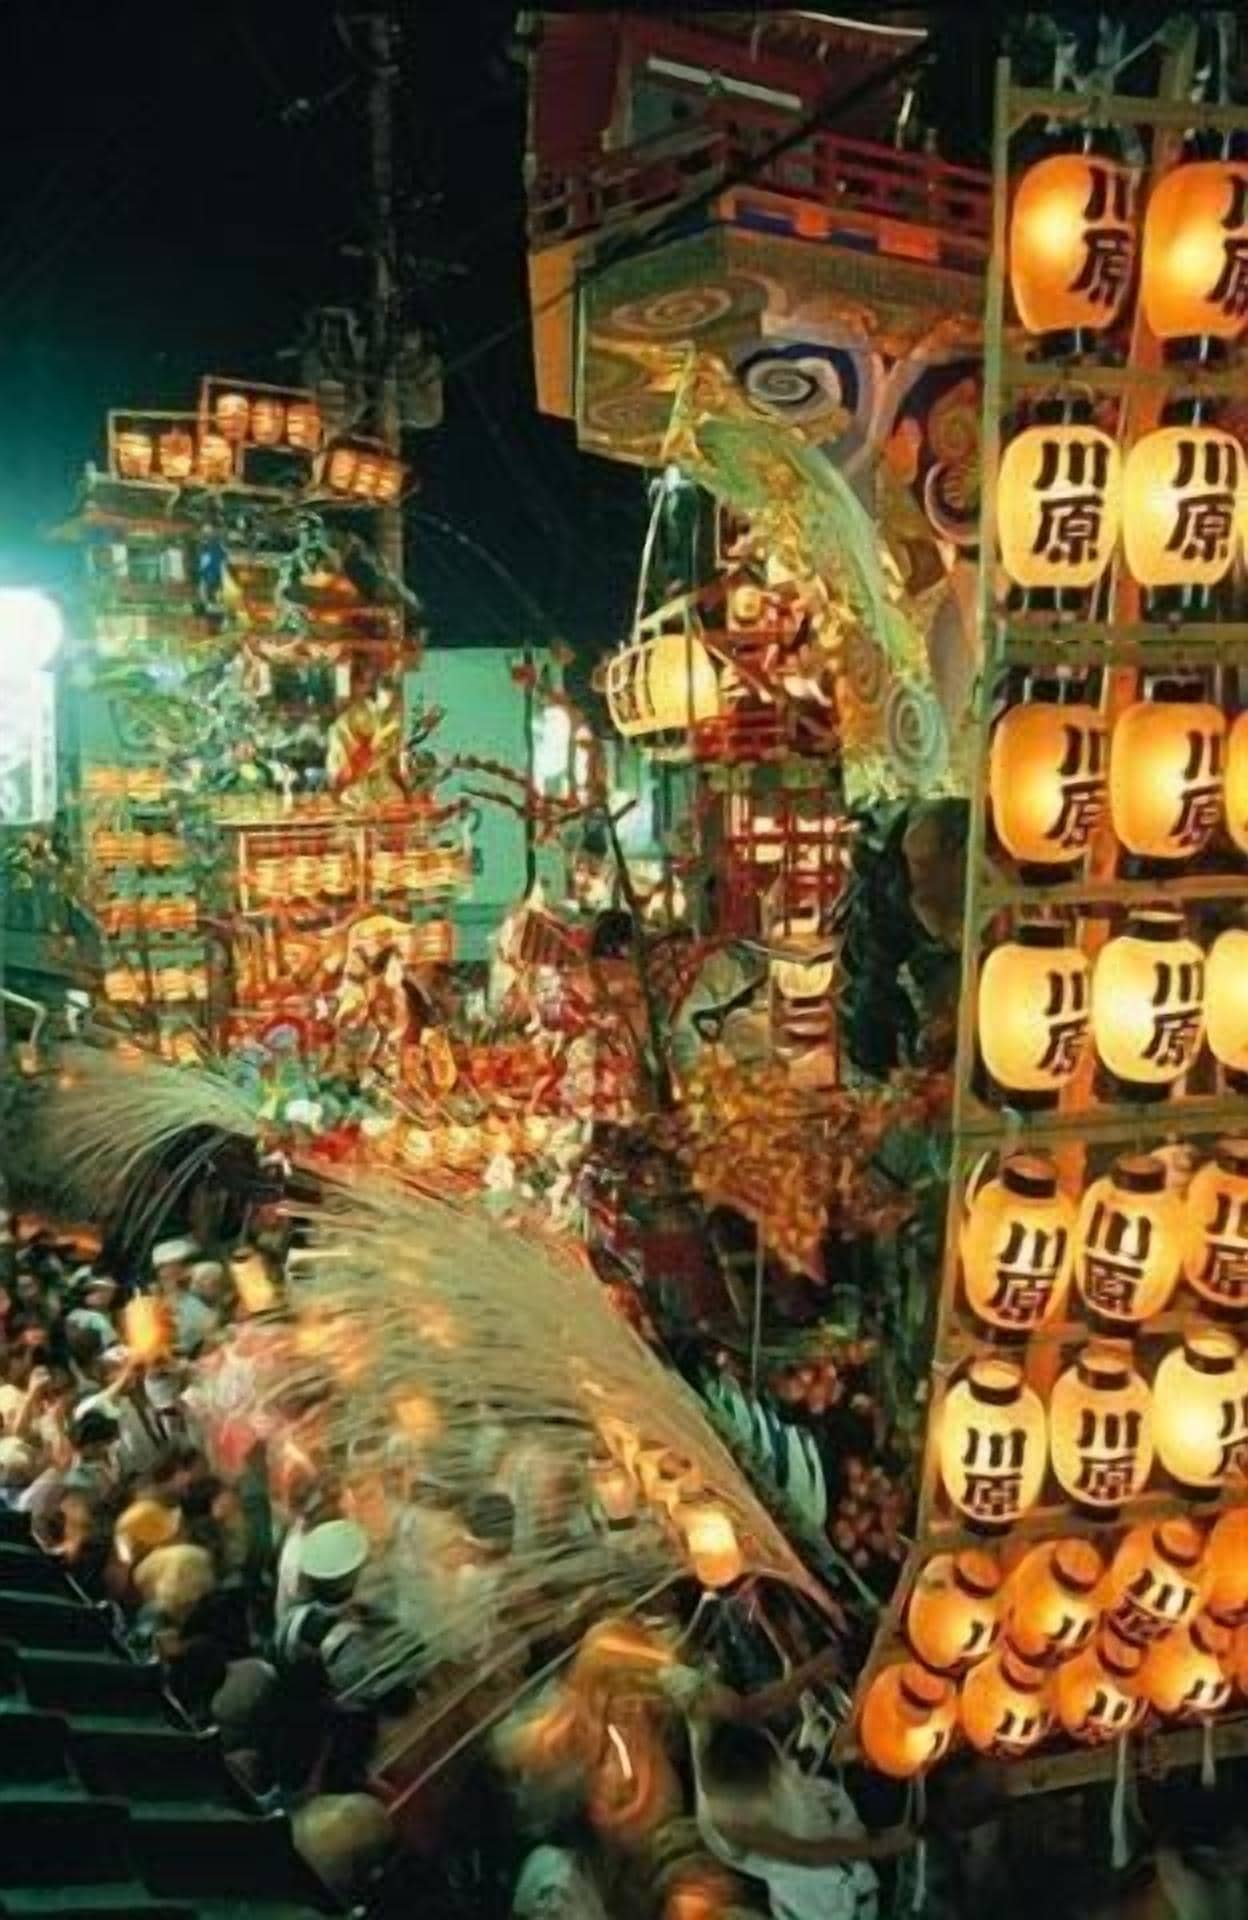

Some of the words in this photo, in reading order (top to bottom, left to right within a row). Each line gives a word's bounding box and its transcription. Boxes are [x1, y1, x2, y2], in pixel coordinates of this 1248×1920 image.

[1068, 166, 1136, 306] 川原
[1032, 440, 1109, 566] 川原
[1166, 440, 1239, 564] 川原
[1045, 725, 1106, 849] 川原
[1037, 970, 1088, 1076] 川原
[1140, 961, 1203, 1068] 川原
[982, 1221, 1067, 1323] 川原
[1084, 1201, 1153, 1315] 川原
[962, 1426, 1027, 1517] 川原
[1074, 1408, 1143, 1500] 川原
